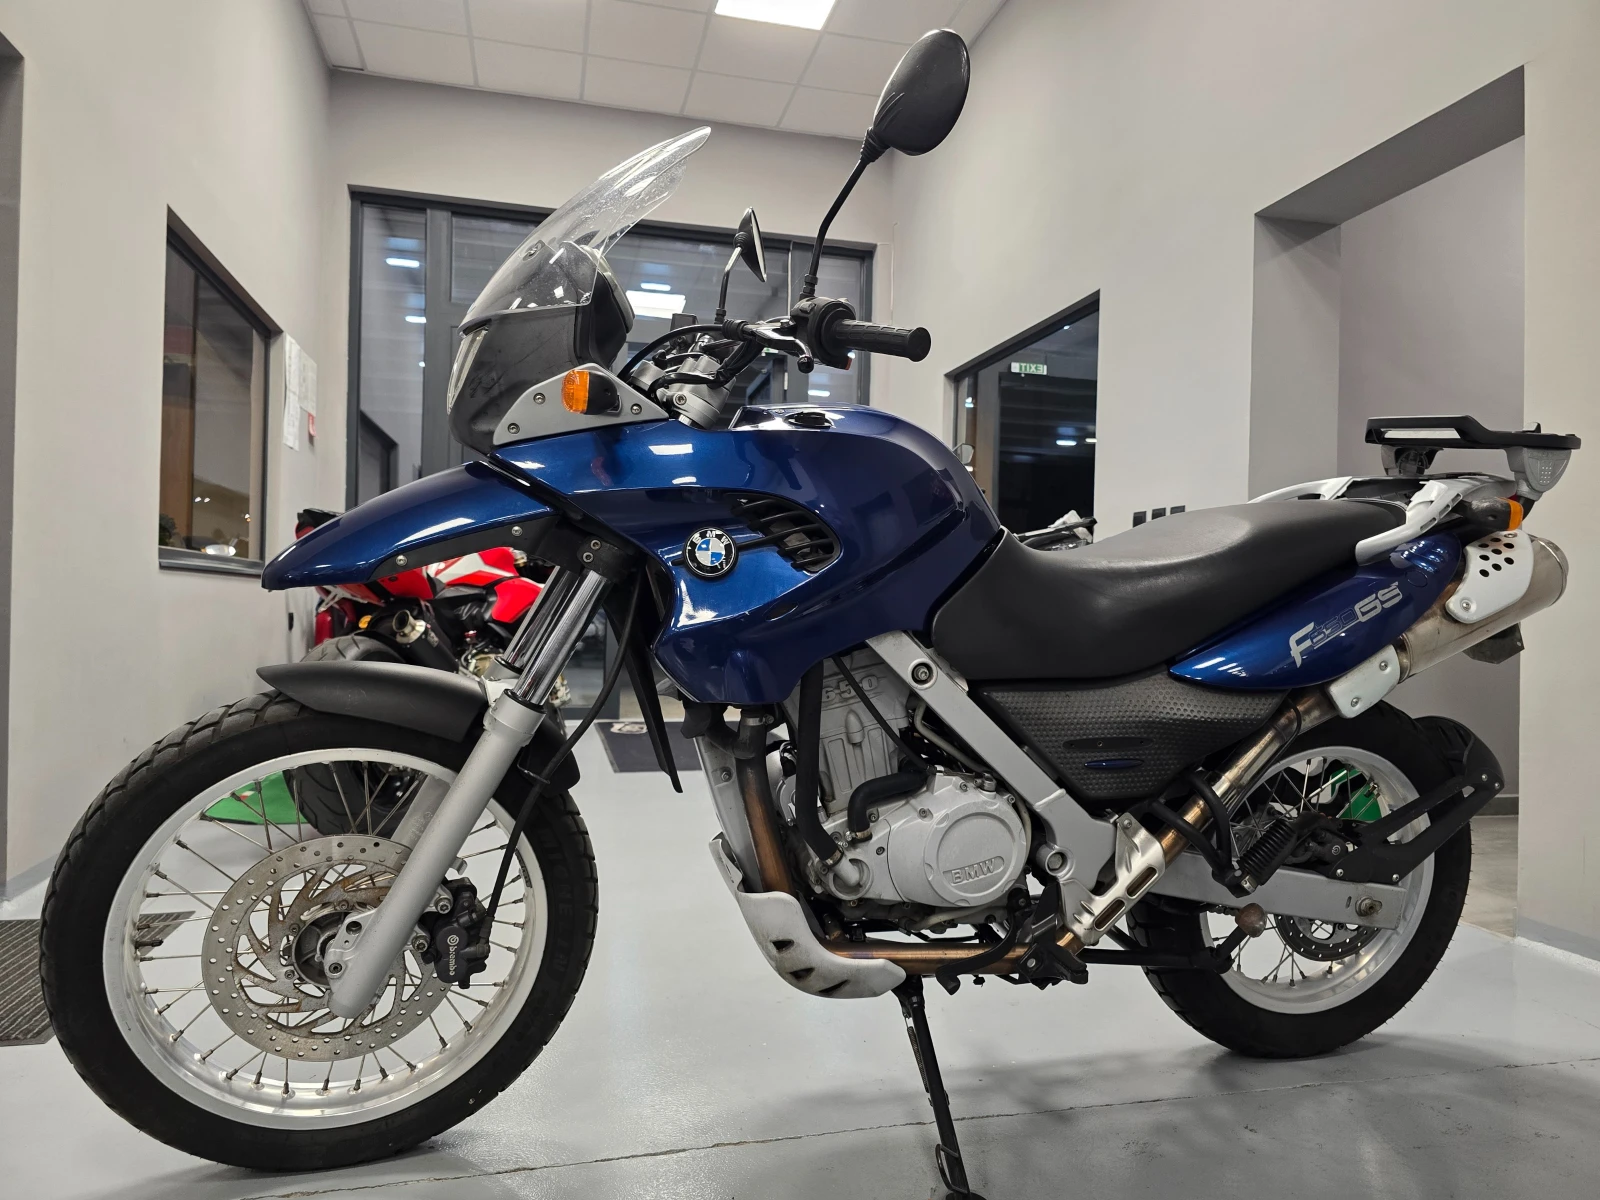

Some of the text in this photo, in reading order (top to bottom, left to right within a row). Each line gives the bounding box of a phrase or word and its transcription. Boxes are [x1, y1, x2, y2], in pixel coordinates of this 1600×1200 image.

[692, 530, 731, 546] BMW
[951, 858, 996, 885] BMW
[537, 827, 575, 973] MICHELIN
[448, 945, 458, 976] brembo
